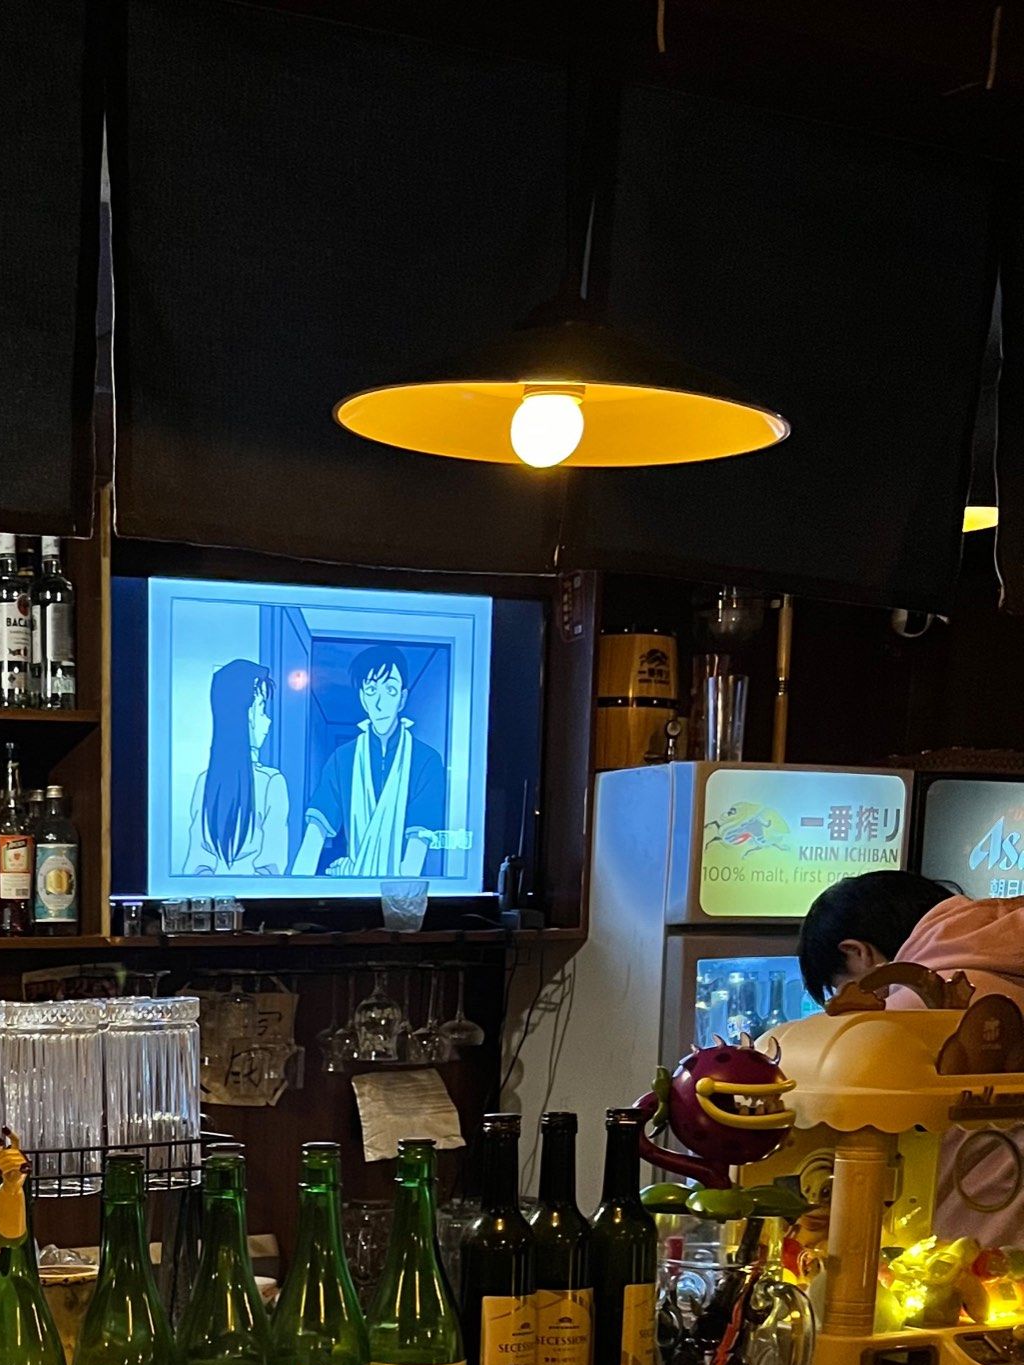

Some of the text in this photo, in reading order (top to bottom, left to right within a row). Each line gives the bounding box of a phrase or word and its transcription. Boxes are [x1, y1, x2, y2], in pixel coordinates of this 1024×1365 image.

[800, 805, 901, 843] 一番搾り
[798, 845, 899, 864] KIRIN ICHIBAN
[702, 866, 745, 883] 100%
[793, 866, 822, 883] first
